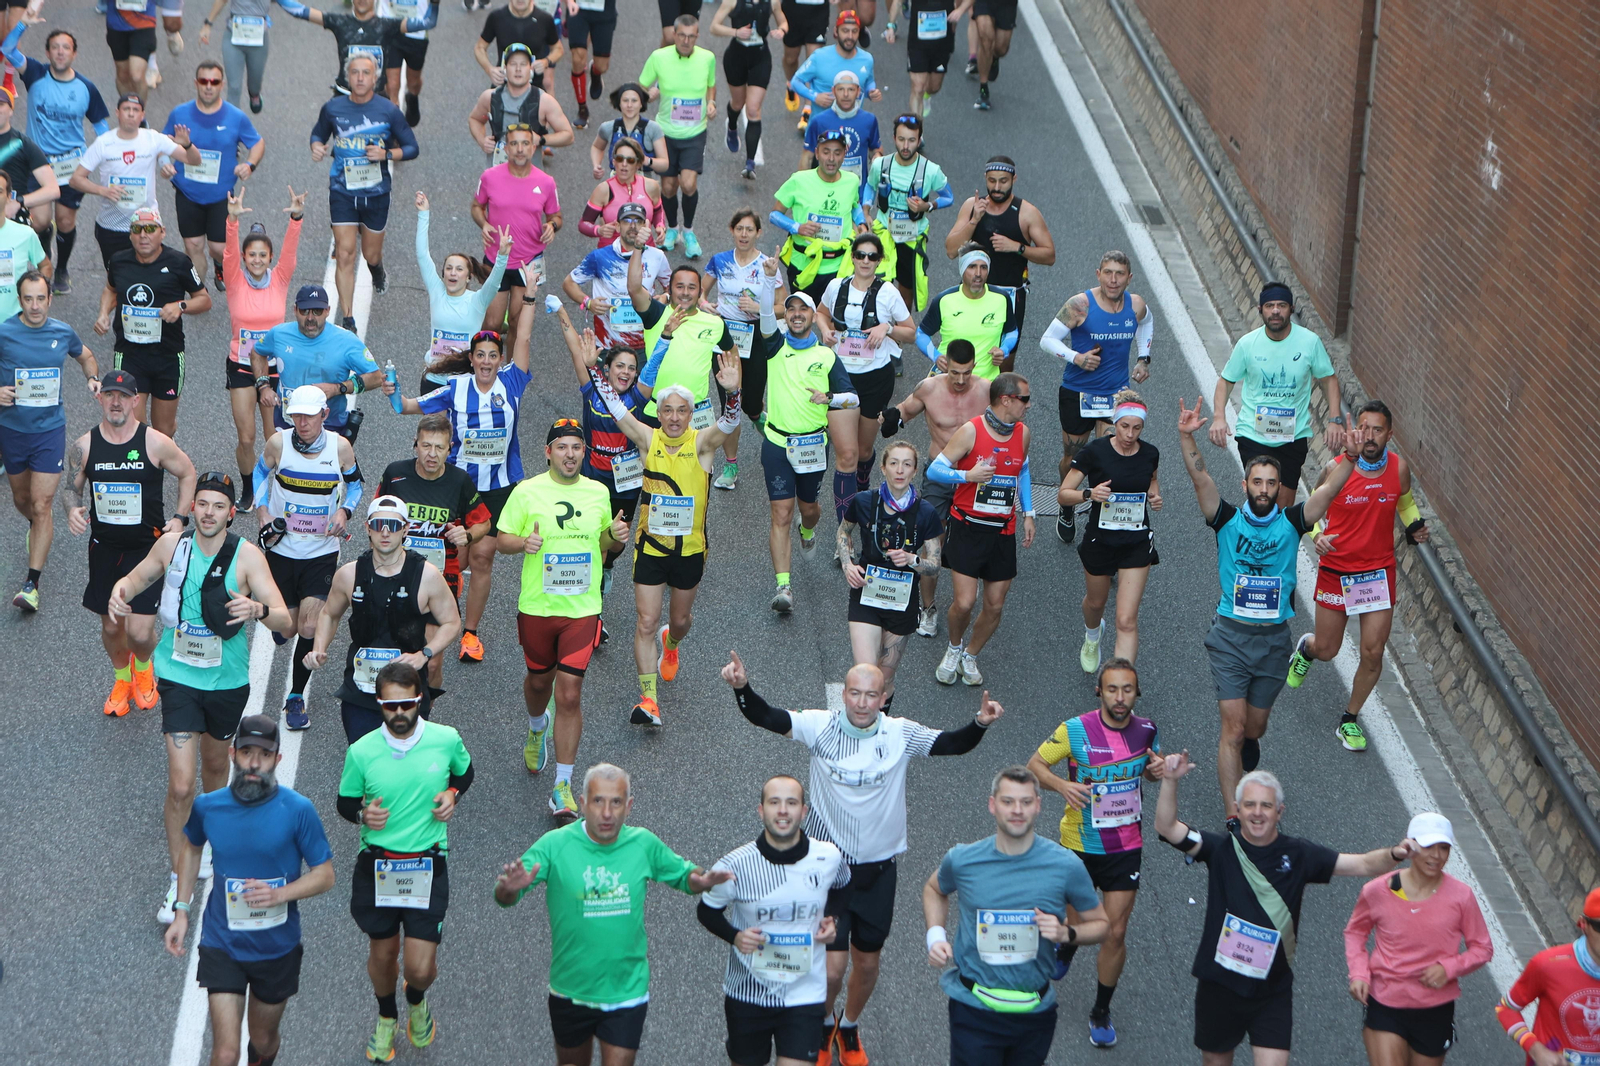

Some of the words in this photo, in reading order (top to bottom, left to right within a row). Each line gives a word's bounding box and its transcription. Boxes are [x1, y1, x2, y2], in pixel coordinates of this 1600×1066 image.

[801, 437, 822, 445] ZURICH
[94, 462, 144, 471] IRELAND
[286, 478, 320, 486] LINLITHGOW
[408, 506, 448, 522] ERUS
[883, 573, 906, 582] ZURICH
[1357, 574, 1379, 582] ZURICH
[878, 584, 896, 593] 10759
[188, 628, 214, 636] ZURICH
[1110, 783, 1135, 792] ZURICH
[1111, 799, 1127, 807] 7580
[396, 862, 425, 870] ZURICH
[584, 897, 630, 906] TRANQUILIDADE
[998, 915, 1029, 923] ZURICH
[998, 932, 1017, 940] 9818
[1241, 925, 1271, 941] ZURICH
[774, 936, 805, 944] ZURICH
[774, 951, 790, 960] 9691
